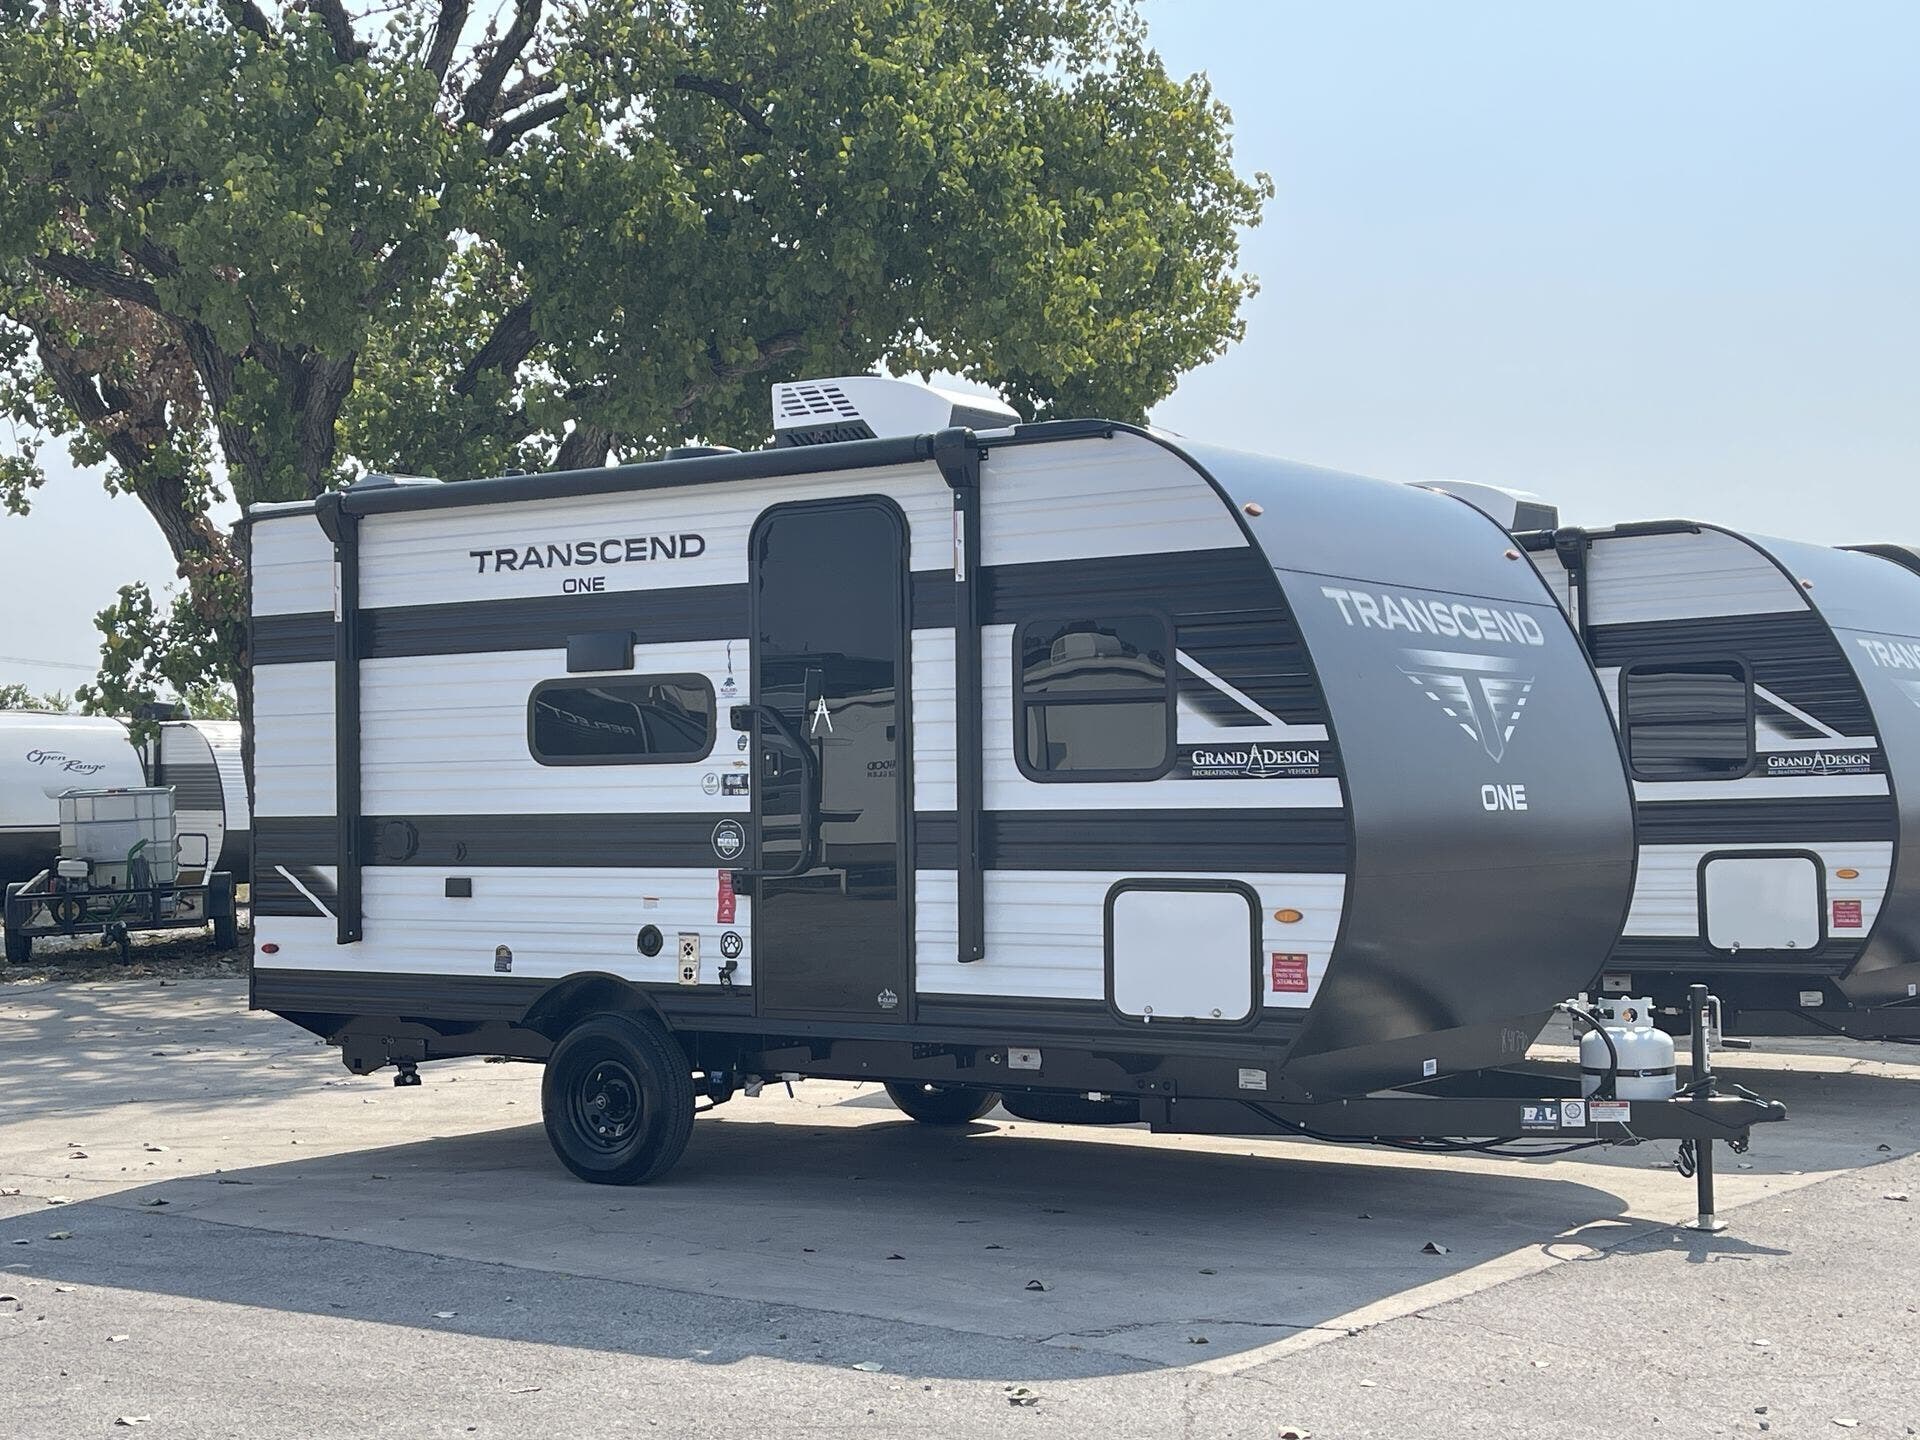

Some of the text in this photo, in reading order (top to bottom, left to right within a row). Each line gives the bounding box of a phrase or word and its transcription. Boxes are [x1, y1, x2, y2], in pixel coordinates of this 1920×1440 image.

[469, 533, 706, 573] TRANSCEND
[562, 576, 606, 593] ONE
[1320, 586, 1545, 646] TRANSCEND
[26, 750, 66, 765] Open
[1192, 749, 1319, 765] GRAND DESIGN
[1767, 754, 1871, 767] GRAND DESIGN
[58, 760, 106, 775] Range
[1481, 784, 1528, 811] ONE
